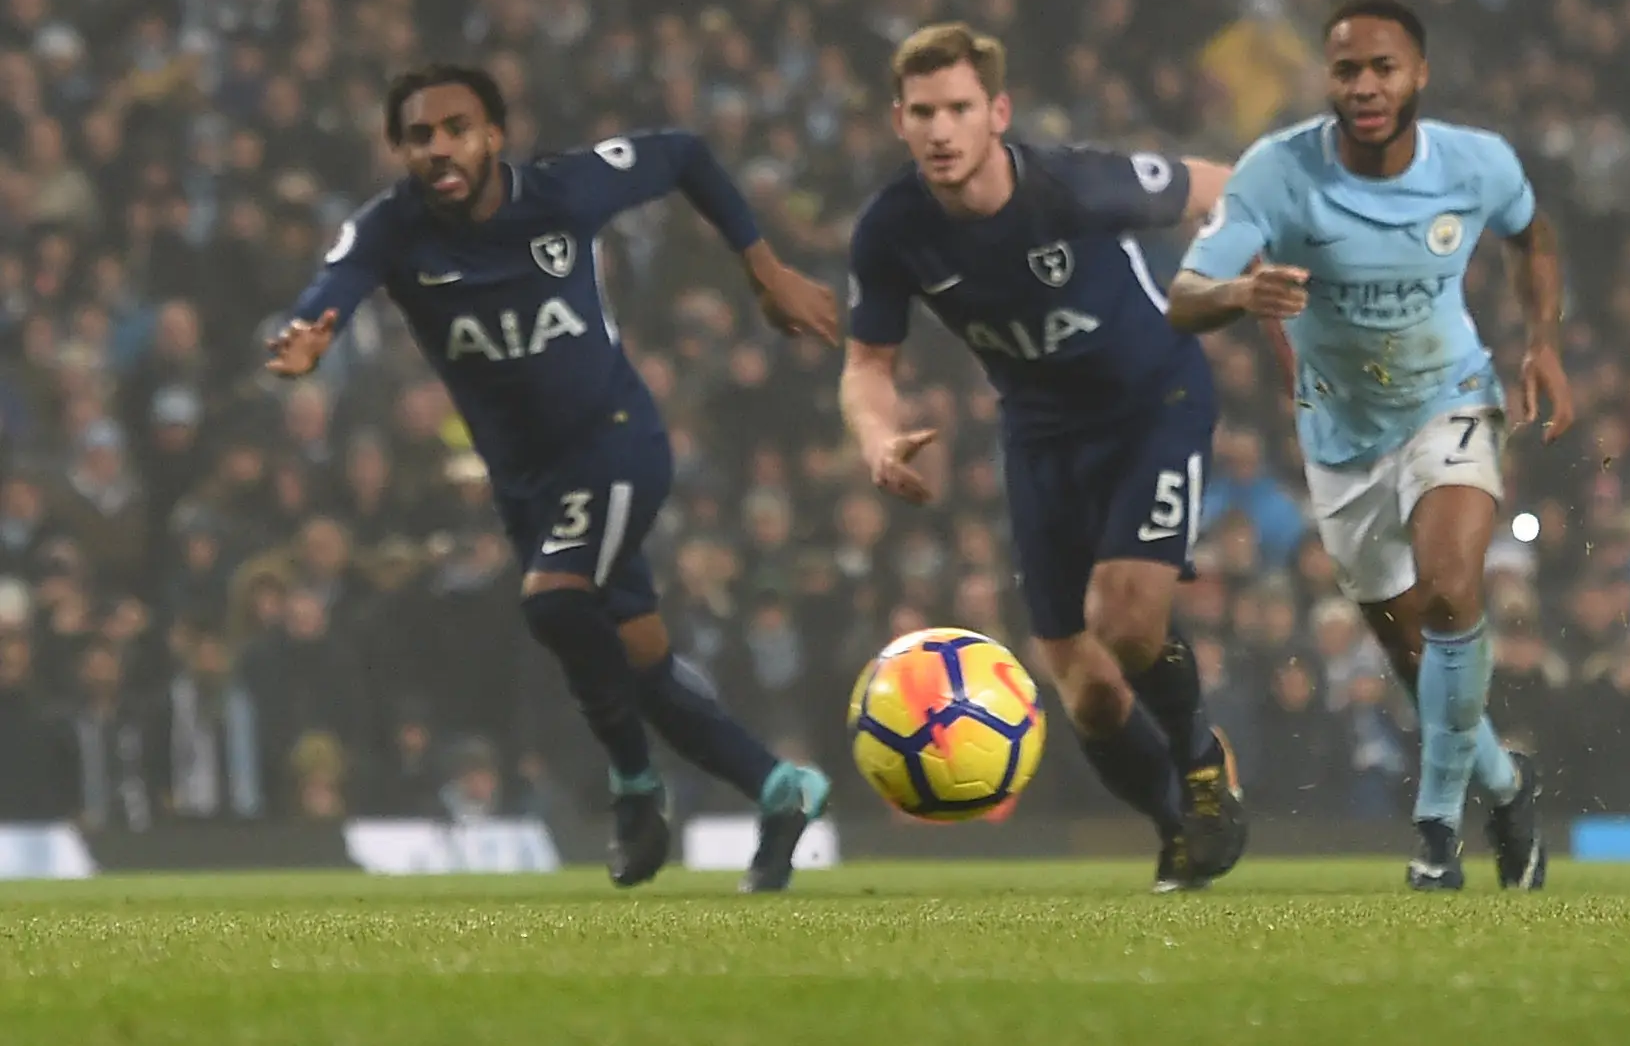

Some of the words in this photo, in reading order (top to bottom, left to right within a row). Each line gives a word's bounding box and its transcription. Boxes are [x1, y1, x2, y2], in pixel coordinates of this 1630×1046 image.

[1320, 275, 1455, 303] TIHA
[449, 297, 587, 361] AIA
[966, 308, 1100, 360] AIA
[1450, 415, 1480, 453] 7
[552, 490, 594, 539] 3
[1150, 469, 1184, 528] 5
